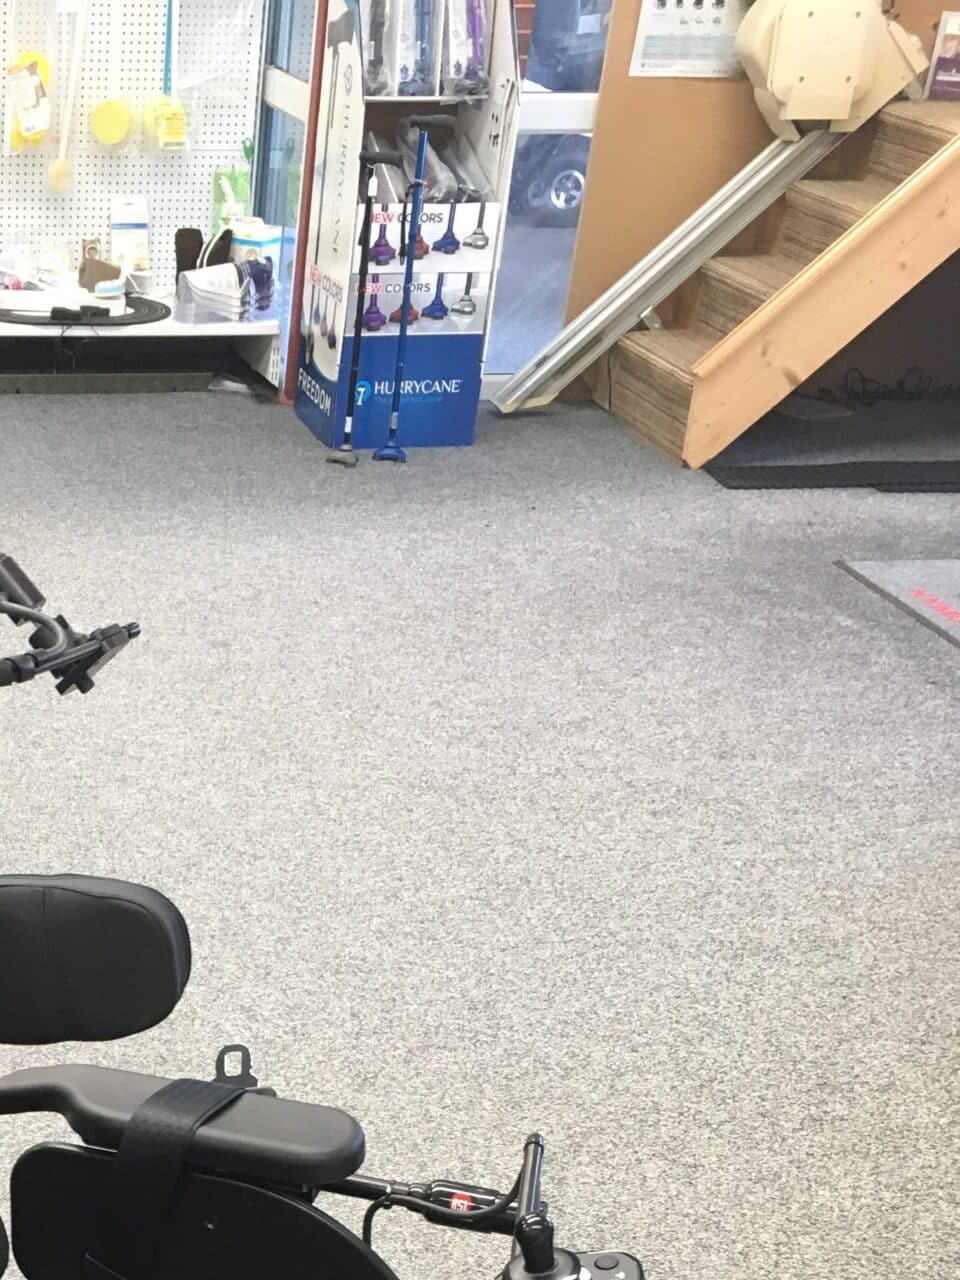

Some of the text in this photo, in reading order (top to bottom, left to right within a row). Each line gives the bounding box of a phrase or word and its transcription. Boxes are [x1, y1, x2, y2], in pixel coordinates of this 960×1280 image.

[370, 212, 443, 223] EW COORS
[384, 282, 431, 294] COORS
[297, 367, 332, 417] FREEDOM
